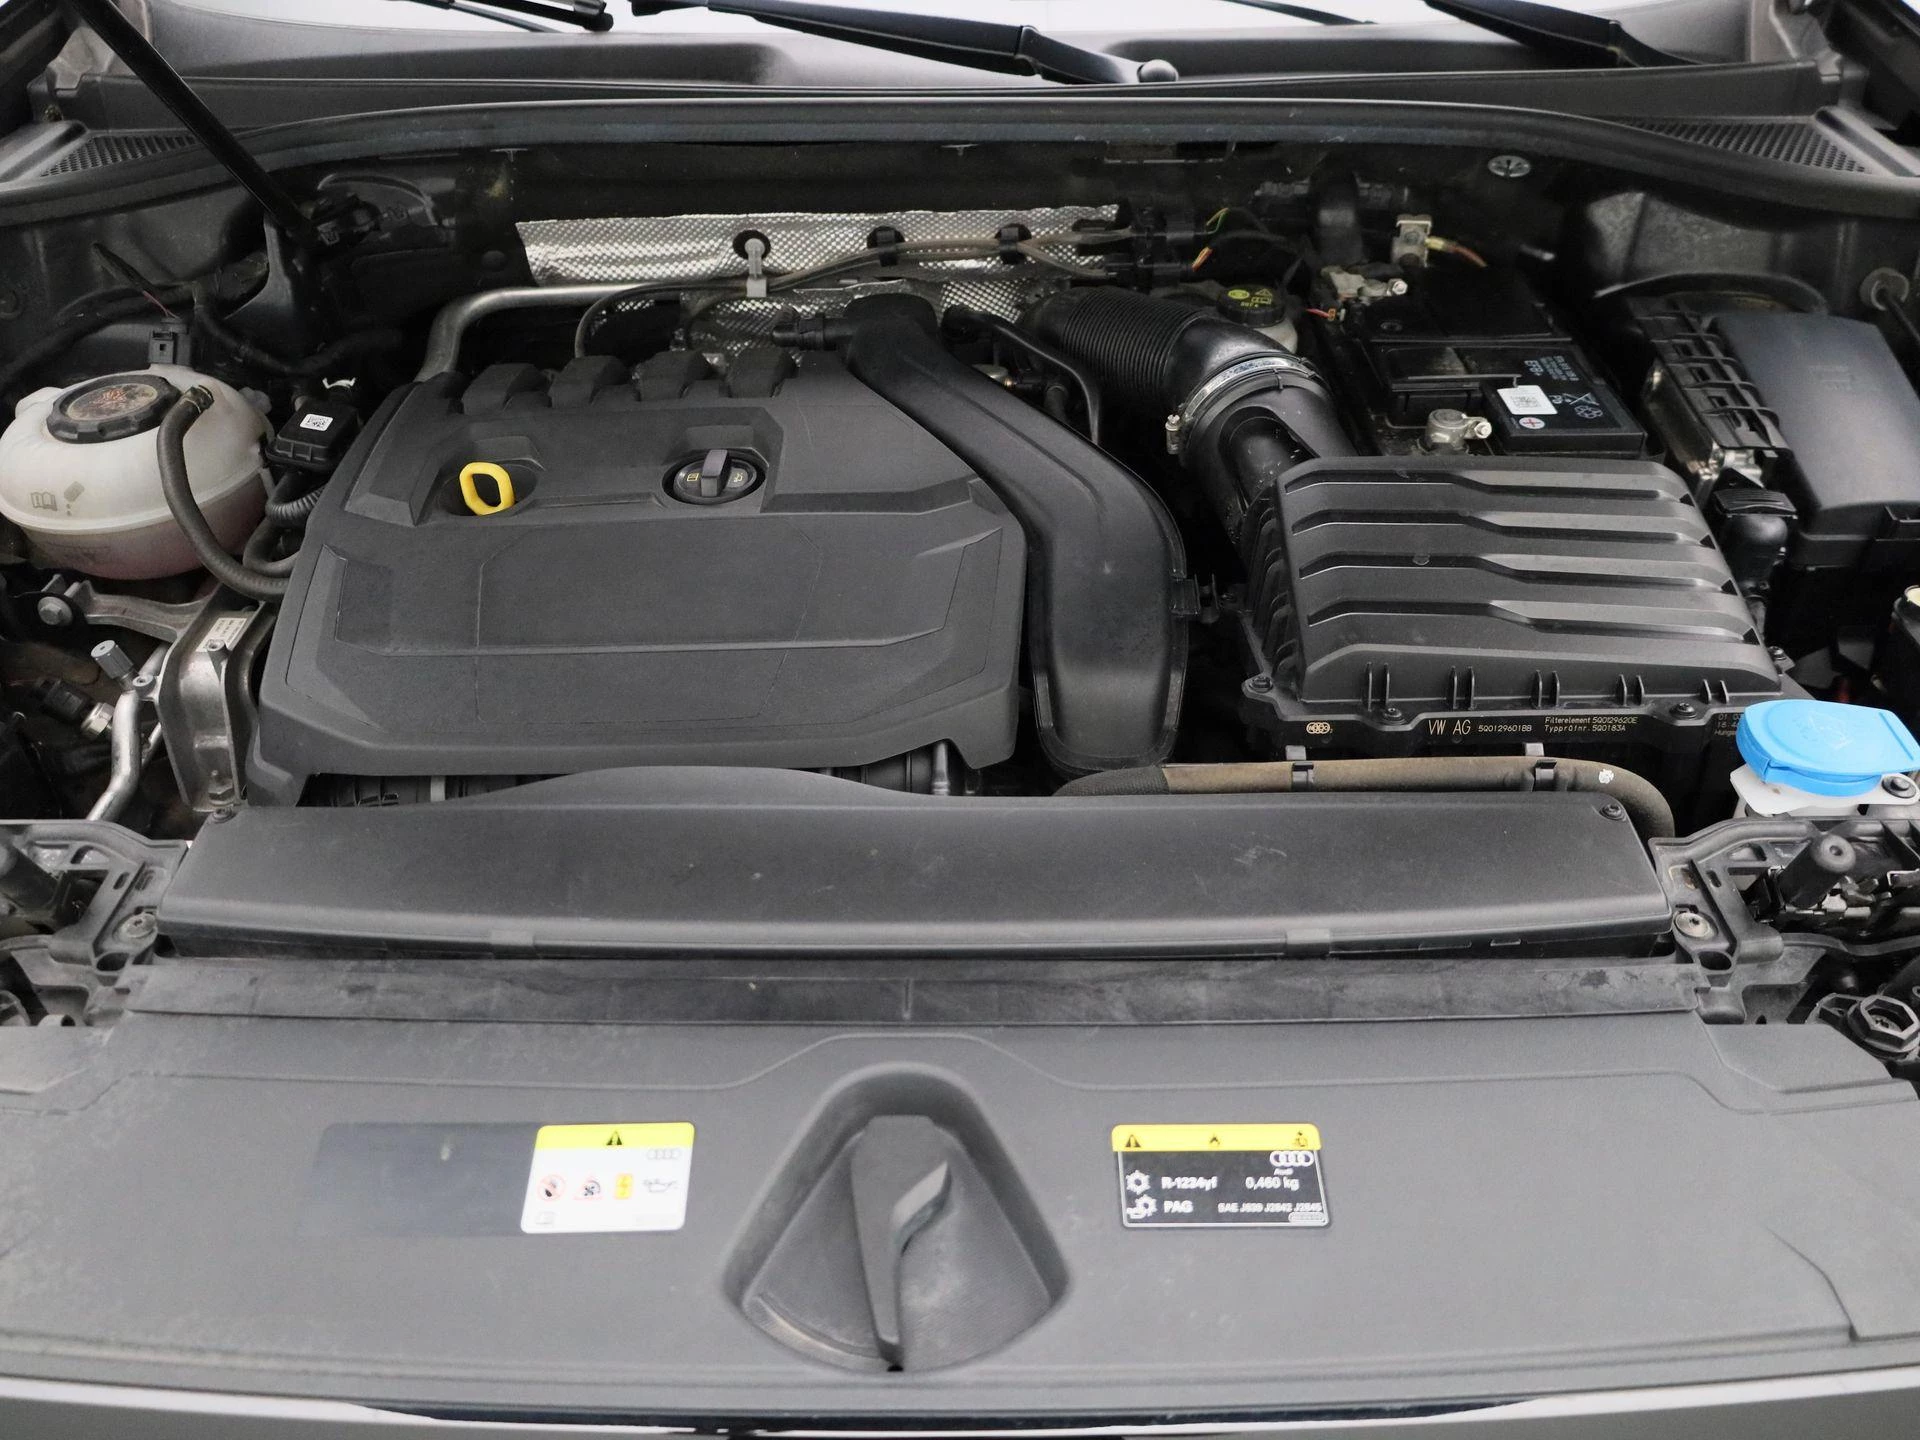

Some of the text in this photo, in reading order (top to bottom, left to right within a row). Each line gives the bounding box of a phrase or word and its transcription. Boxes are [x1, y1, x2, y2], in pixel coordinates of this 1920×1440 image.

[1428, 719, 1446, 735] VW
[1452, 719, 1471, 735] AG
[1545, 716, 1590, 724] Filterelement
[1283, 1176, 1300, 1192] kg
[1163, 1200, 1194, 1213] PAG
